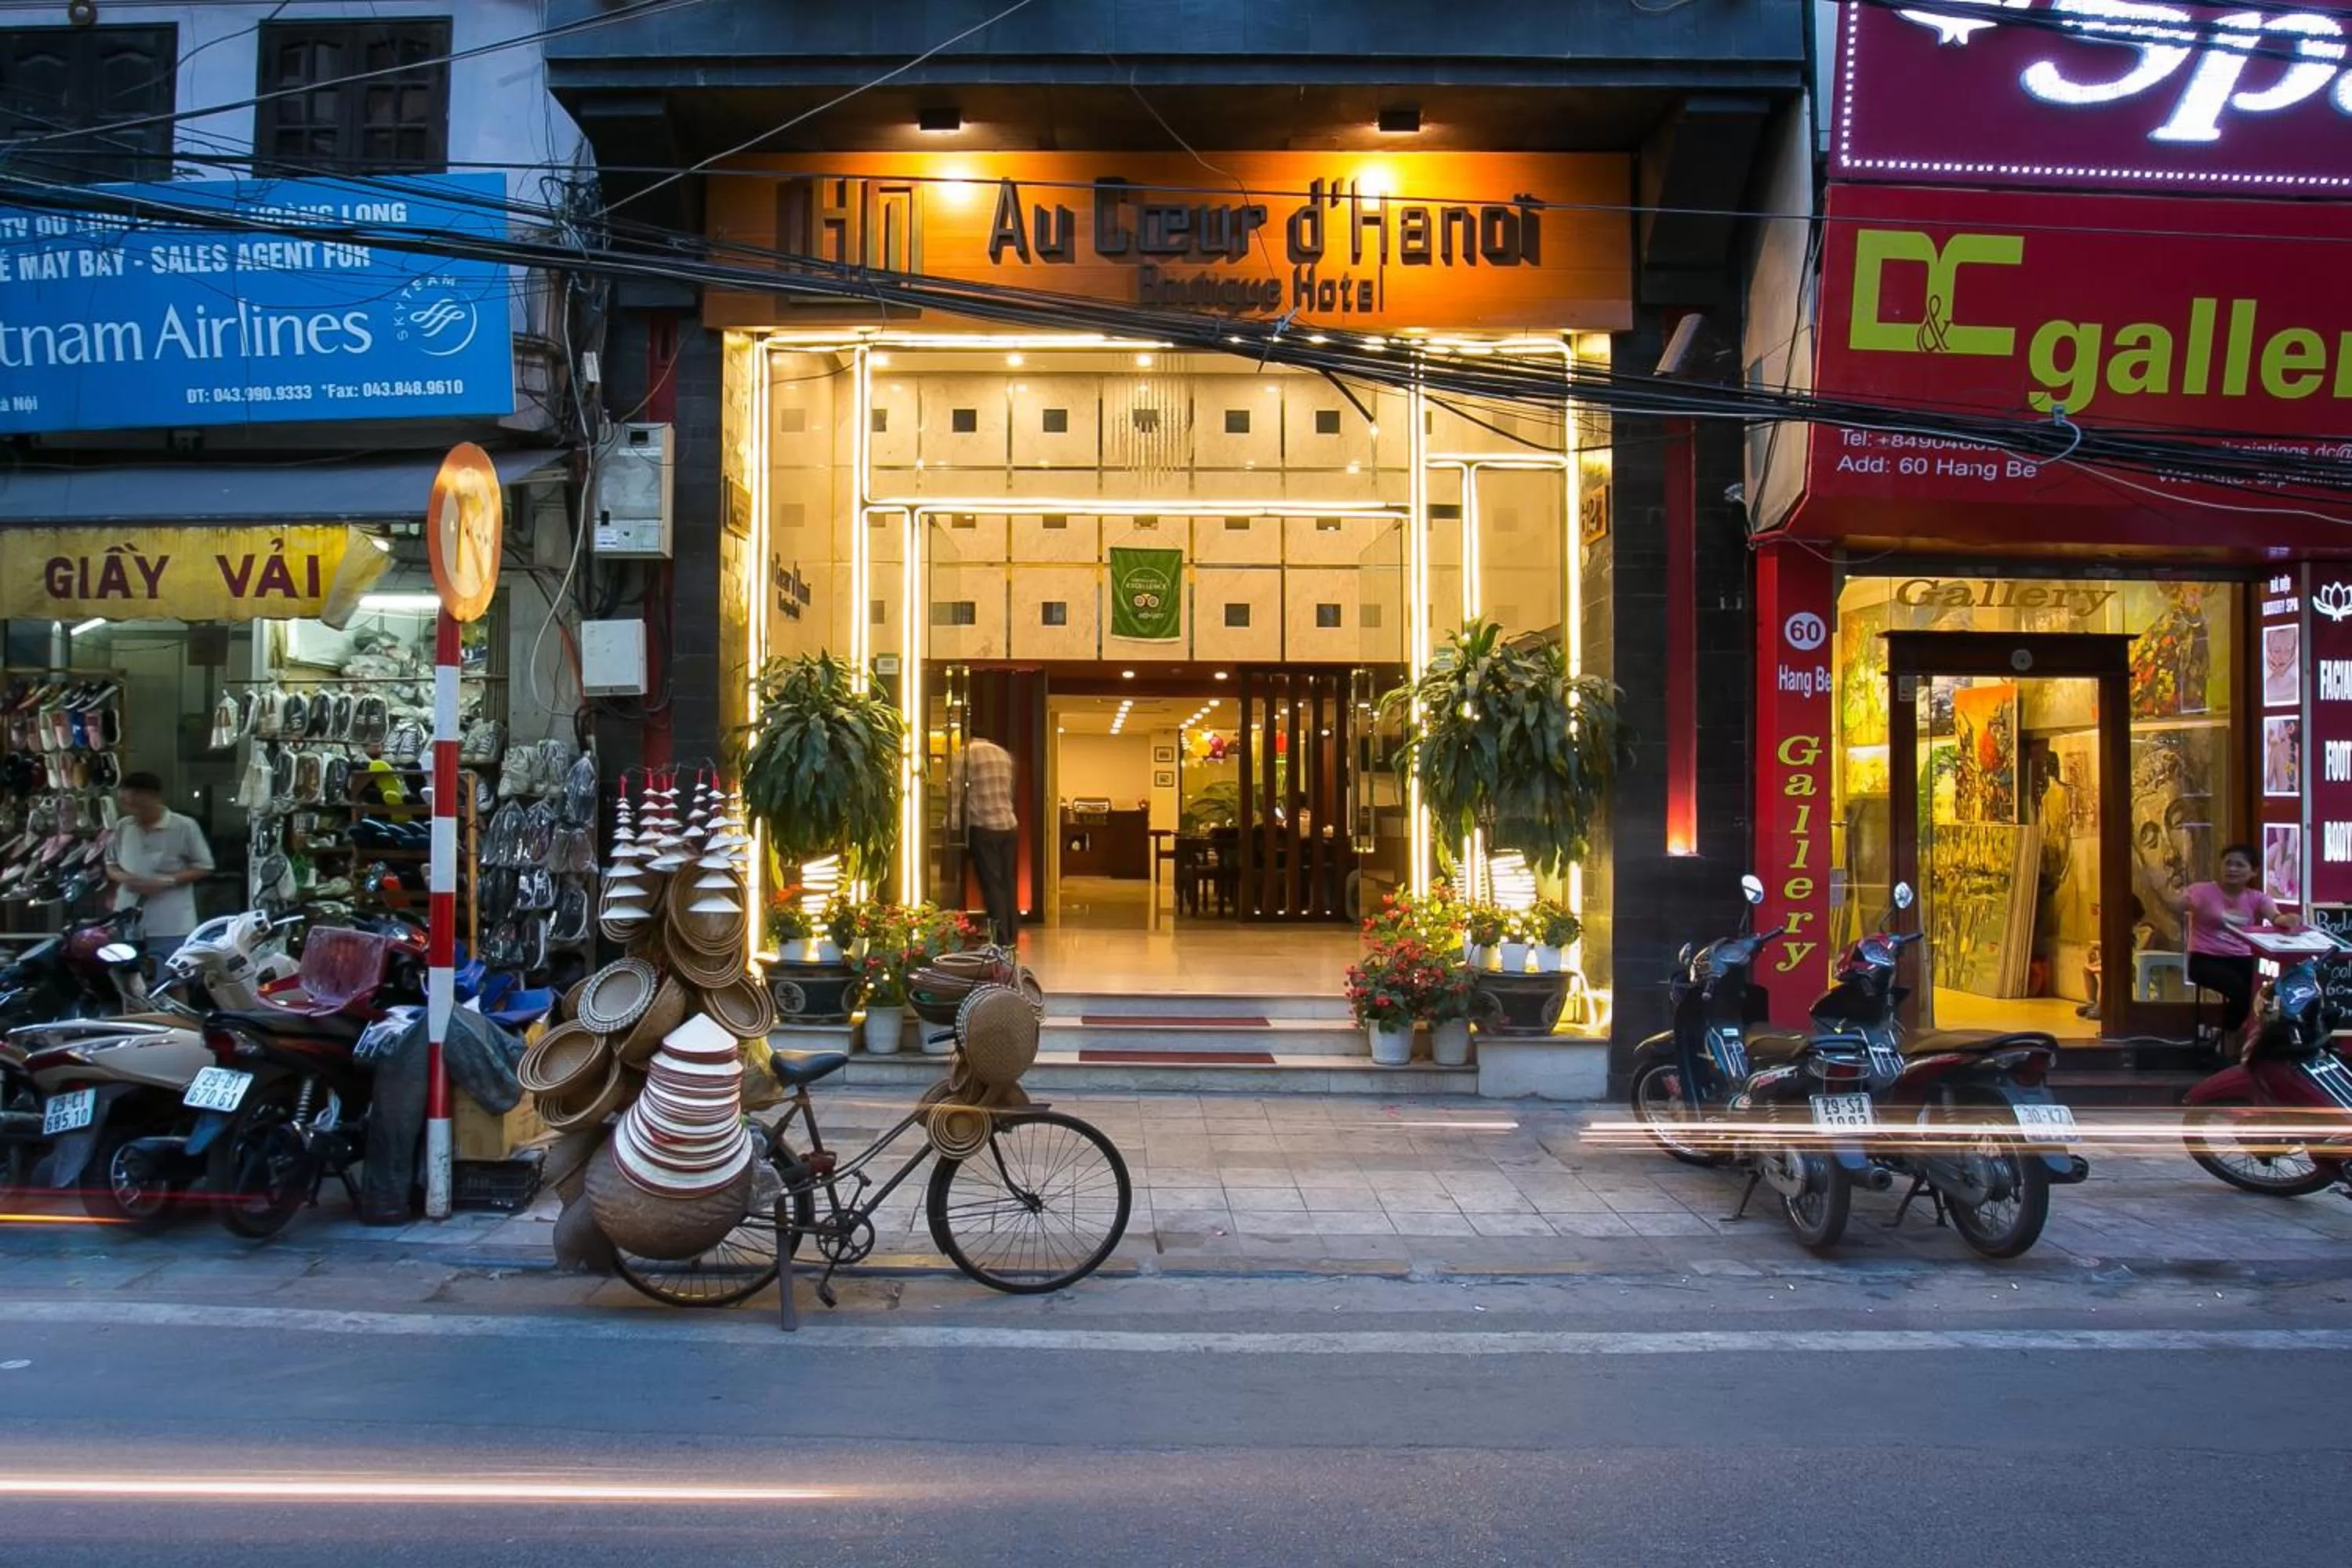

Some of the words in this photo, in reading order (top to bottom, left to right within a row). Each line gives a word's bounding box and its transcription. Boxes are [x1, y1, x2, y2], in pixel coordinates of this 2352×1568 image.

[2020, 0, 2352, 141] Sp
[341, 201, 407, 224] LONG
[989, 177, 1075, 264] Au
[19, 245, 71, 280] MÁY
[78, 248, 125, 277] BAY
[151, 243, 229, 274] SALES
[237, 241, 315, 270] AGENT
[322, 241, 371, 268] FOR
[392, 274, 456, 342] SKYTEAM
[1292, 263, 1384, 313] Hotel
[154, 298, 373, 360] Airlines
[1839, 430, 1873, 448] Tel:
[1836, 455, 1891, 474] Add:
[1899, 457, 1929, 475] 60
[1936, 459, 1998, 481] Hang
[2006, 460, 2038, 478] Be
[45, 543, 170, 599] GIẦY
[216, 538, 321, 598] VẢI
[1896, 579, 2117, 617] Gallery
[1790, 620, 1820, 641] 60
[1779, 664, 1812, 698] Hang
[1816, 666, 1832, 691] Be
[1777, 735, 1822, 971] Gallery
